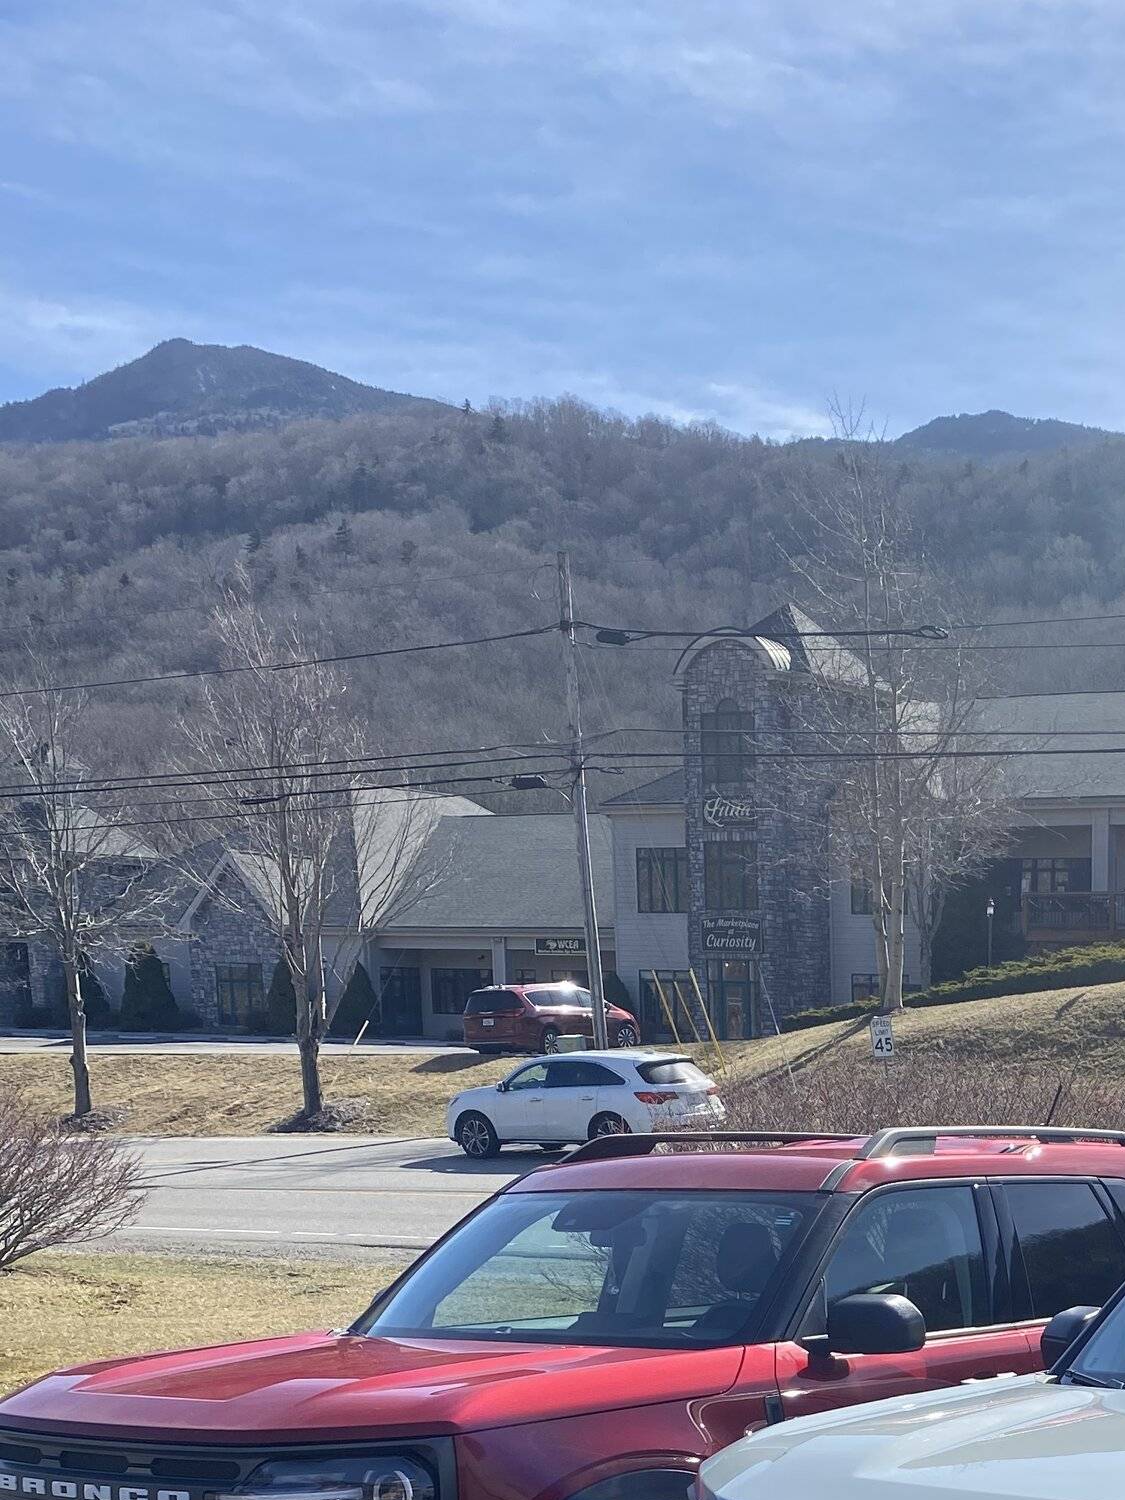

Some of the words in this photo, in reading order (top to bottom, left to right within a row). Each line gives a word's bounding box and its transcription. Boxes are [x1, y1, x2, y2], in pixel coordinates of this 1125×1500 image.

[702, 919, 714, 928] The
[716, 918, 759, 929] Marketplace
[706, 934, 756, 951] Curiosity
[875, 1037, 893, 1052] 45
